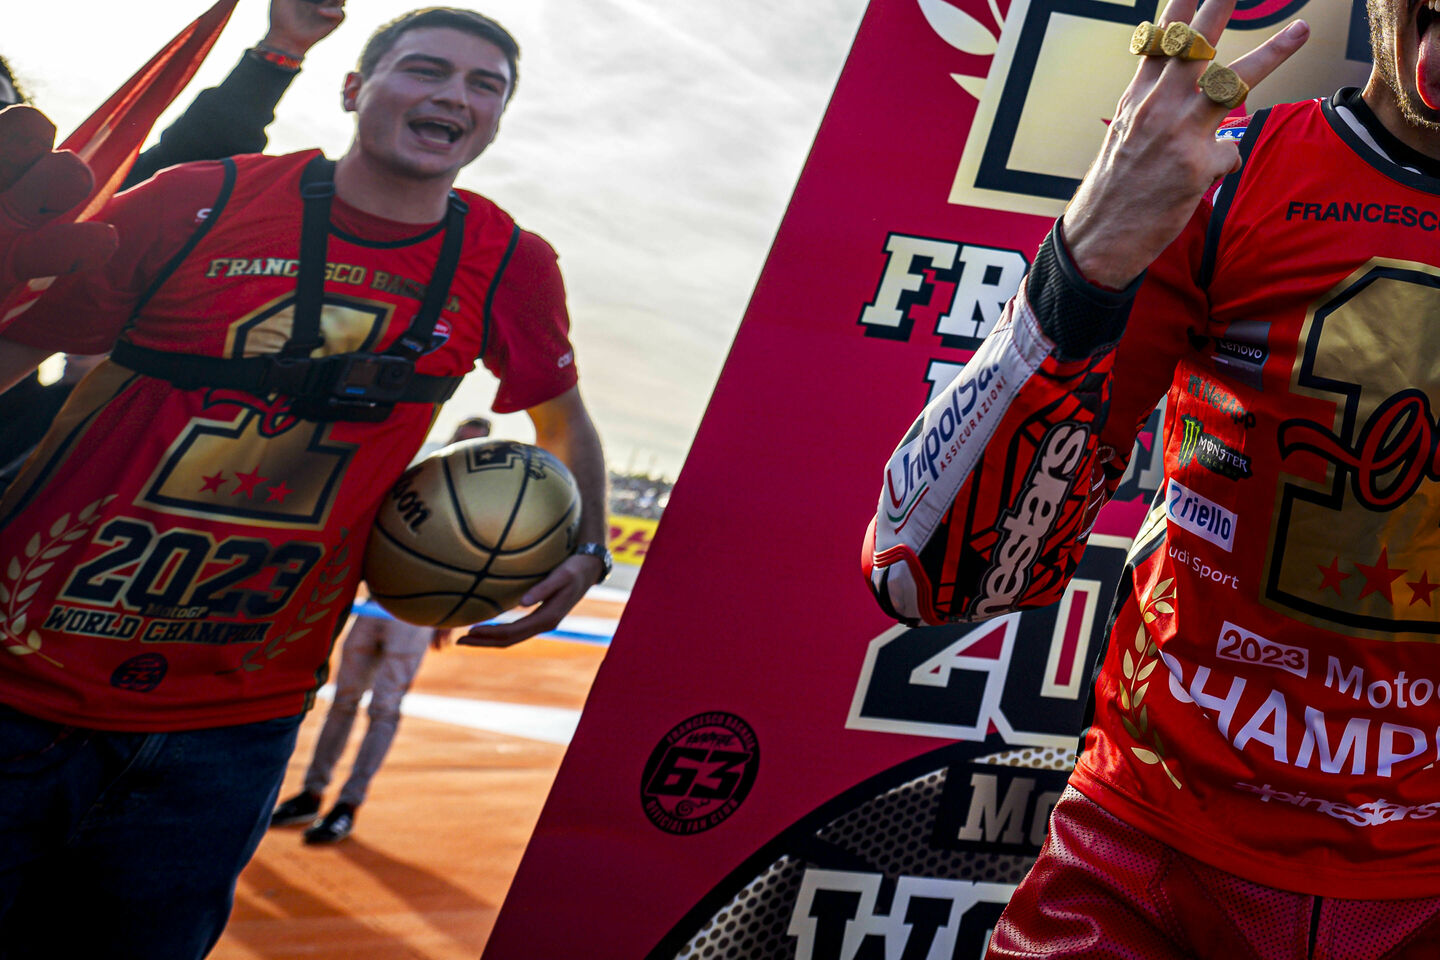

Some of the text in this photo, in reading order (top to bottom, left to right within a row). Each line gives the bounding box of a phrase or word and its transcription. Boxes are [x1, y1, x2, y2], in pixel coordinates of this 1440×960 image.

[206, 257, 368, 286] FRANCSCO
[940, 375, 1007, 472] ASSICURAZIONI
[1202, 384, 1256, 430] NetApp
[1180, 496, 1232, 540] riello
[56, 515, 326, 619] 2023
[1168, 546, 1240, 590] udi Sport
[42, 605, 143, 640] WORLD
[1219, 628, 1307, 671] 2023
[666, 714, 725, 744] FRANCESCO
[646, 746, 753, 800] 63
[645, 799, 739, 833] OFFICIAL FAN CLUB
